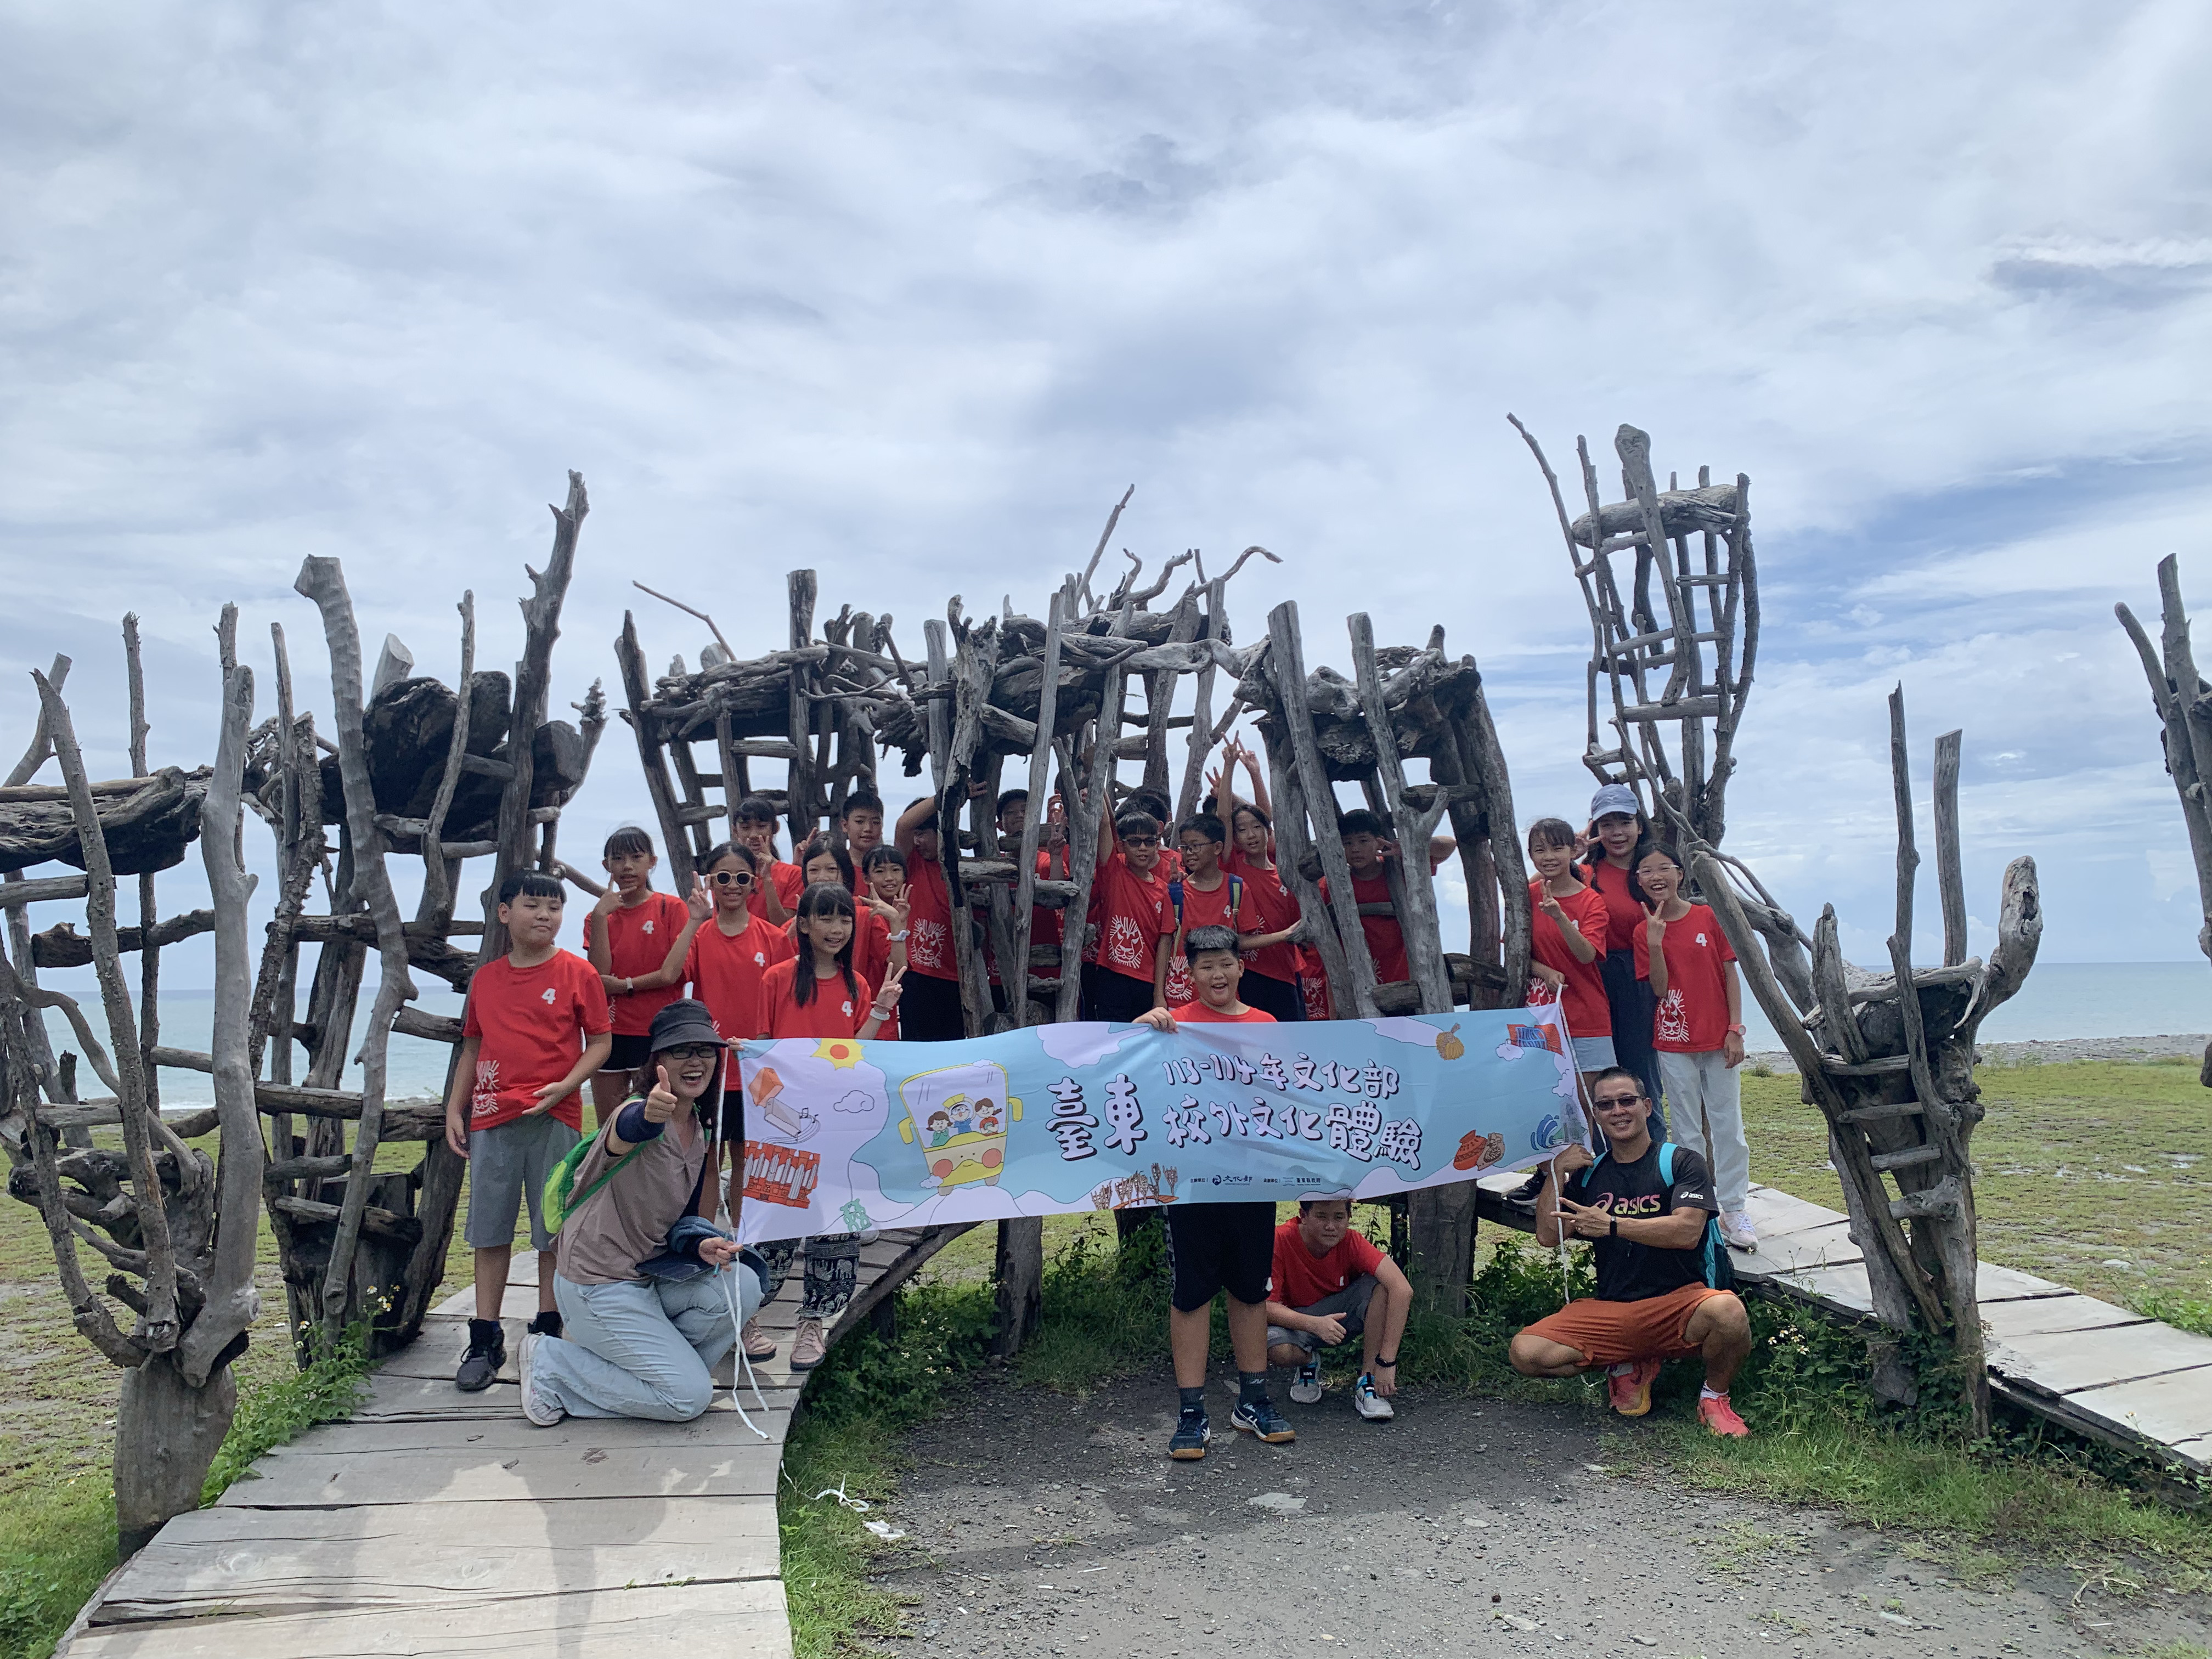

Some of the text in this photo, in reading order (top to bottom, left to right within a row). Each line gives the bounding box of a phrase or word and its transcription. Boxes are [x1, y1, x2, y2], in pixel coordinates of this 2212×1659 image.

[1279, 884, 1288, 897] 4
[1155, 901, 1162, 913] 4
[1223, 905, 1231, 918] 4
[642, 920, 654, 934] 4
[1696, 933, 1707, 946] 4
[754, 951, 765, 967] 4
[541, 988, 556, 1005] 4
[842, 1001, 853, 1017] 4
[1161, 1052, 1400, 1099] 113-114年文化部
[1046, 1073, 1148, 1161] 臺東
[1162, 1093, 1421, 1171] 校外文化體驗
